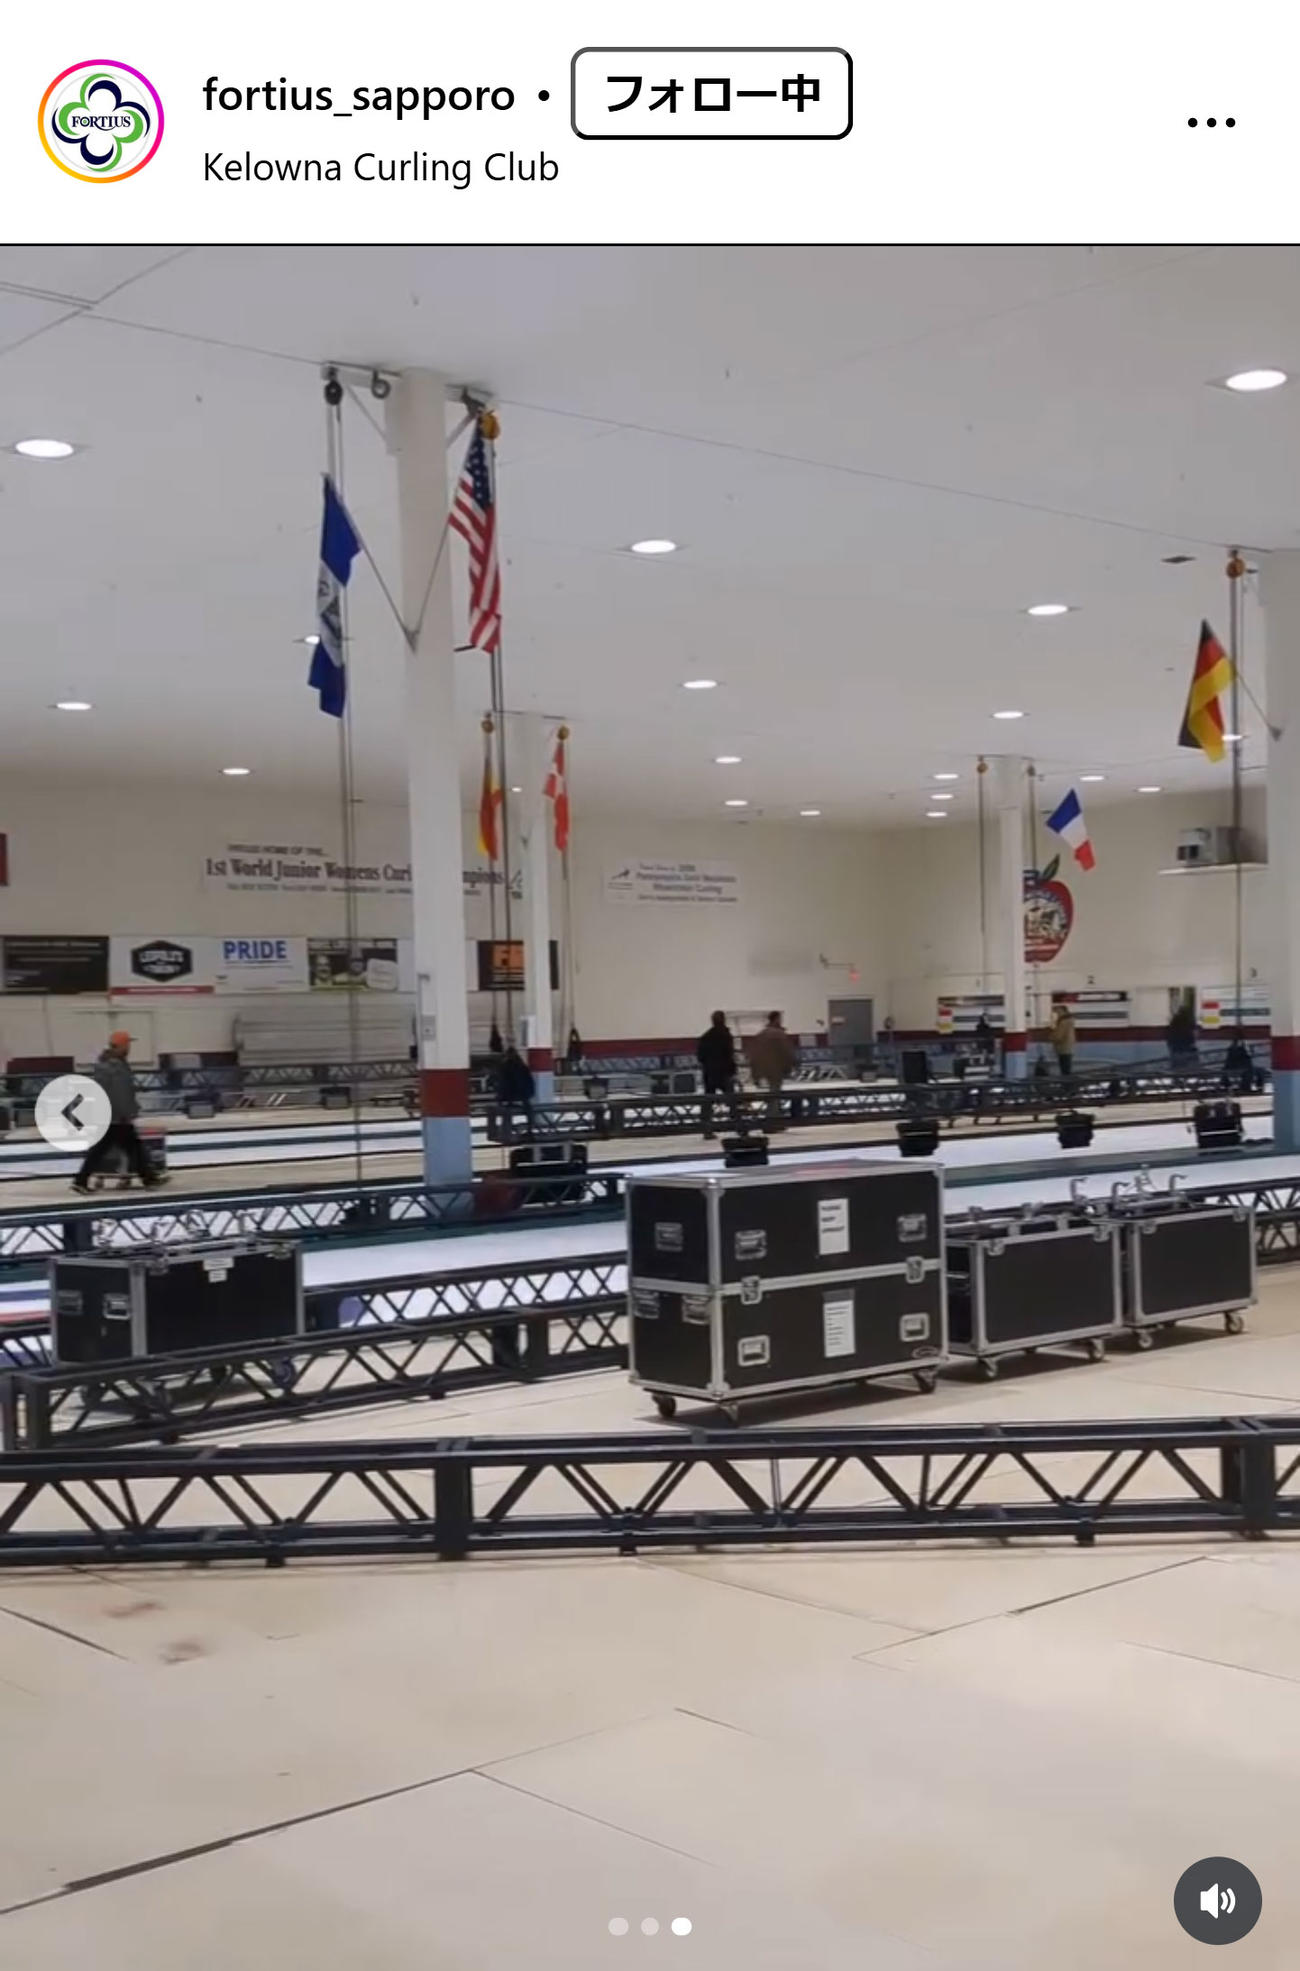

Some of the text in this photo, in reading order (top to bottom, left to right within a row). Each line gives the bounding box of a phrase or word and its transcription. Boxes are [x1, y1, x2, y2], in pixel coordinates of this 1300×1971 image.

[206, 858, 228, 876] 1st
[229, 858, 273, 877] World
[273, 860, 322, 881] Junior
[324, 861, 381, 880] Womens
[383, 863, 413, 881] Curl
[223, 940, 287, 960] PRIDE
